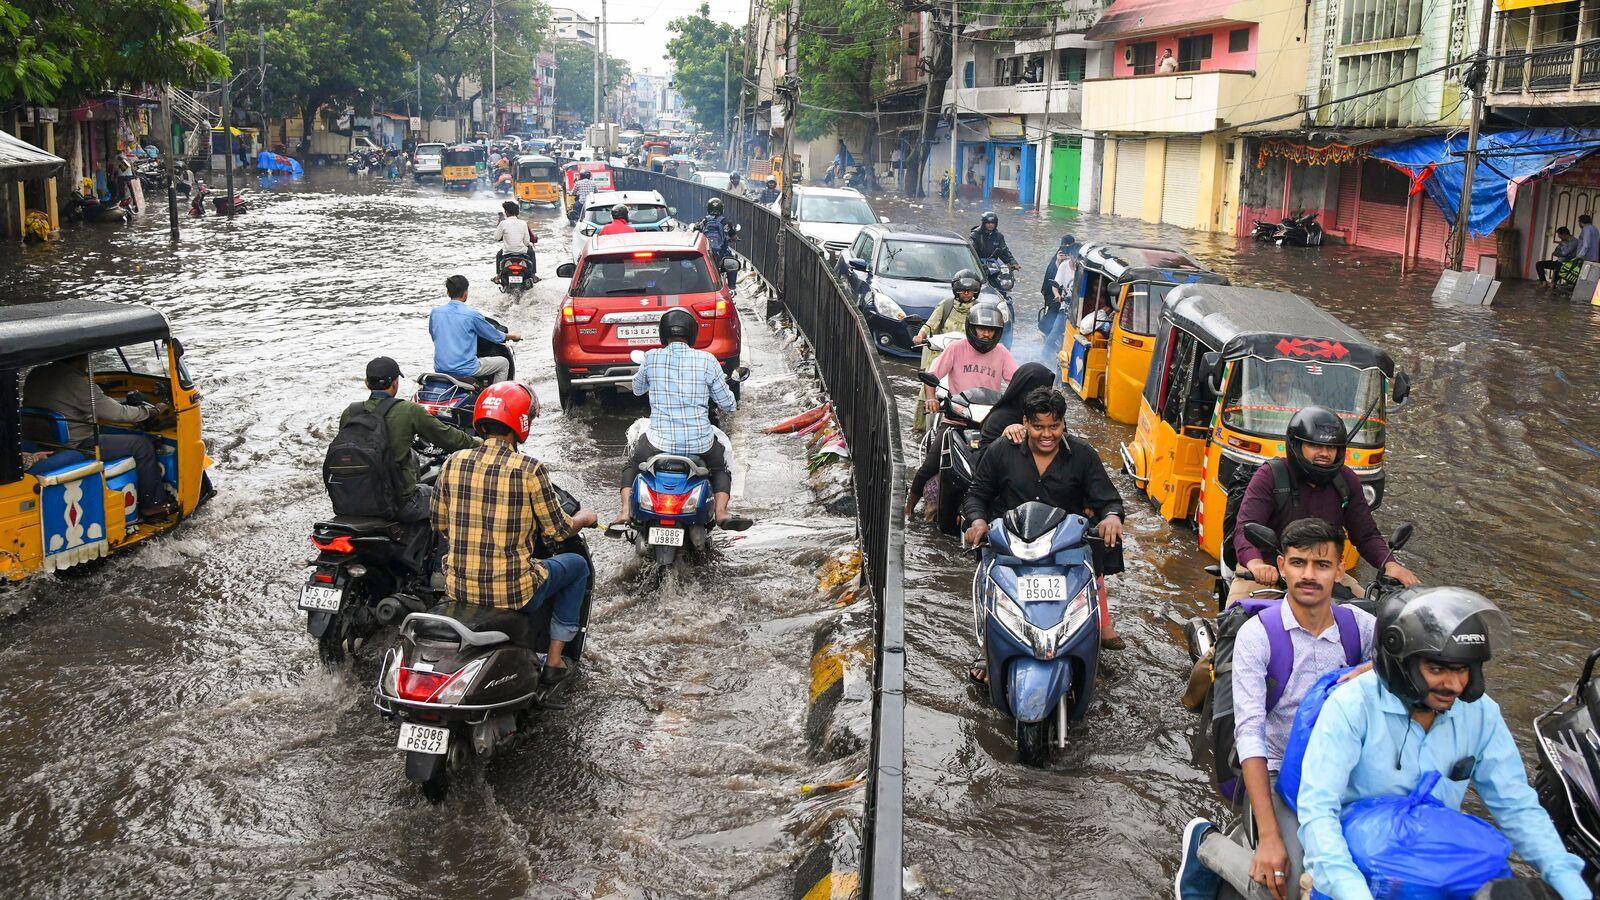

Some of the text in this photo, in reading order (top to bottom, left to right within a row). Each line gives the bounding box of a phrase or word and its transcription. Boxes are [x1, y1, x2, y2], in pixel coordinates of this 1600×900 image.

[963, 364, 996, 378] MAFIA
[481, 396, 503, 406] ACC
[655, 528, 680, 538] TS08G
[1026, 578, 1061, 589] TG 12
[1026, 588, 1061, 599] B5004
[411, 725, 444, 741] TS08G
[406, 737, 441, 753] P6947
